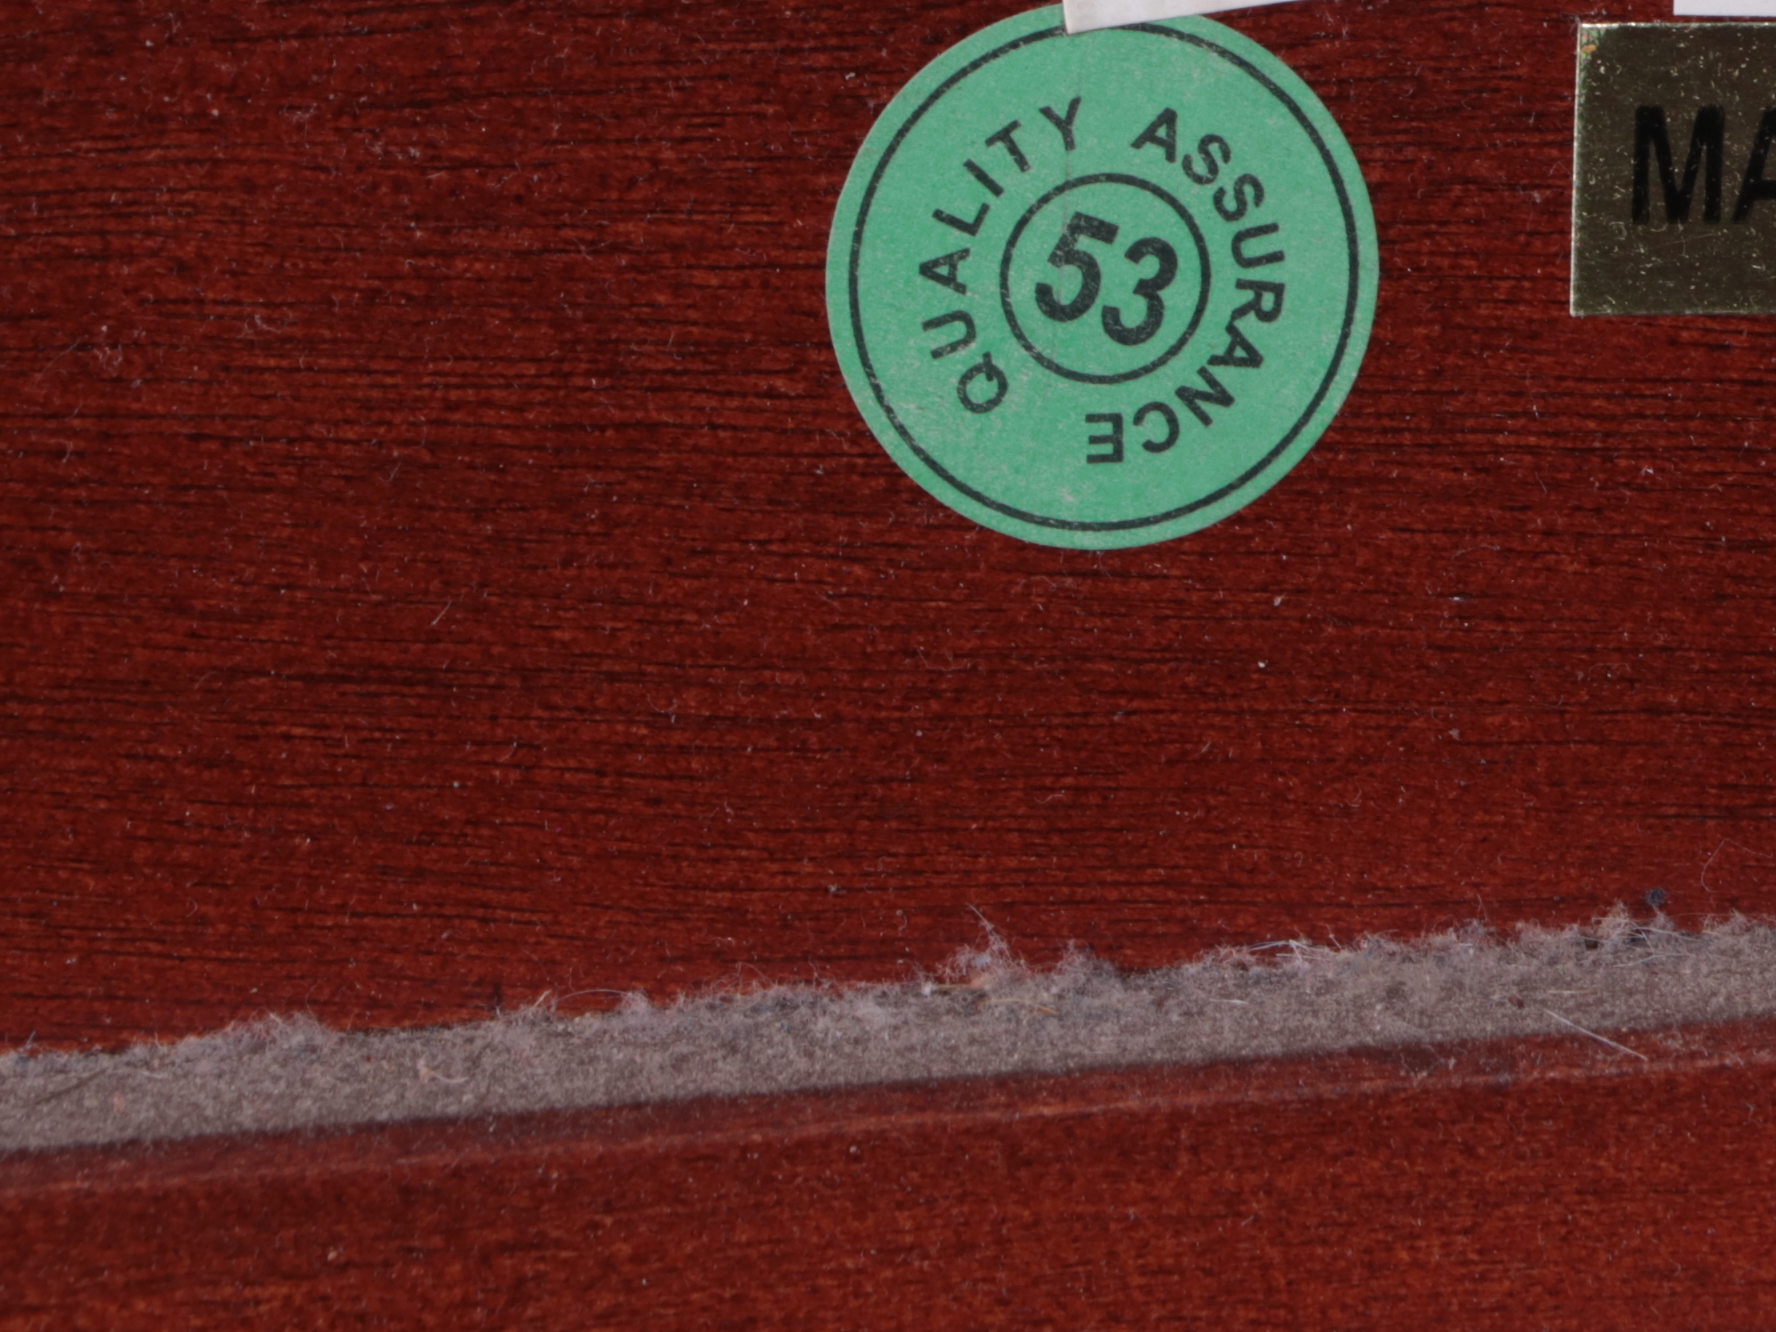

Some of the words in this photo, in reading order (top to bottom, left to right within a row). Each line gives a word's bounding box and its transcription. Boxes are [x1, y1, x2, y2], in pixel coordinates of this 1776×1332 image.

[918, 96, 1083, 414] QUALITY
[1085, 107, 1285, 464] ASSURANCE
[1034, 211, 1178, 346] 53
